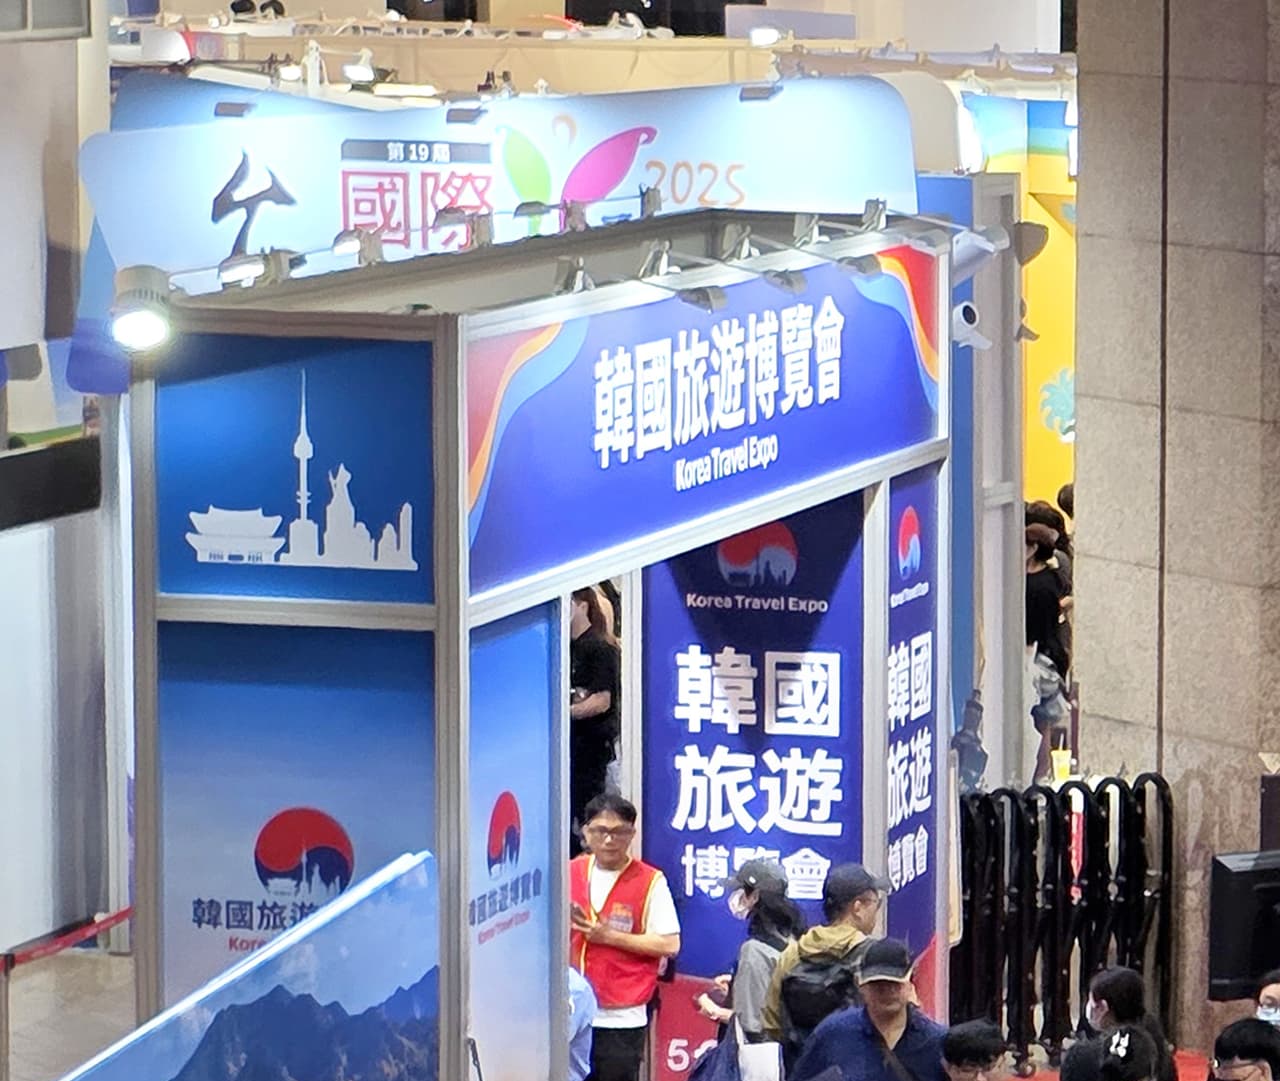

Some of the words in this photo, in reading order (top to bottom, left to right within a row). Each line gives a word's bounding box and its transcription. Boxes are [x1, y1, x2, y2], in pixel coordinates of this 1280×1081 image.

[341, 168, 493, 251] 國際
[644, 159, 746, 209] 2025
[594, 295, 845, 470] 韓國旅遊博覽會
[676, 455, 711, 492] Korea
[711, 438, 748, 481] Travel
[749, 434, 778, 470] Expo
[686, 592, 733, 609] Korea
[735, 594, 785, 611] Travel
[788, 597, 828, 614] Expo
[675, 645, 840, 737] 韓國
[888, 631, 932, 730] 韓國
[672, 744, 843, 836] 旅遊
[887, 726, 932, 829] 旅遊
